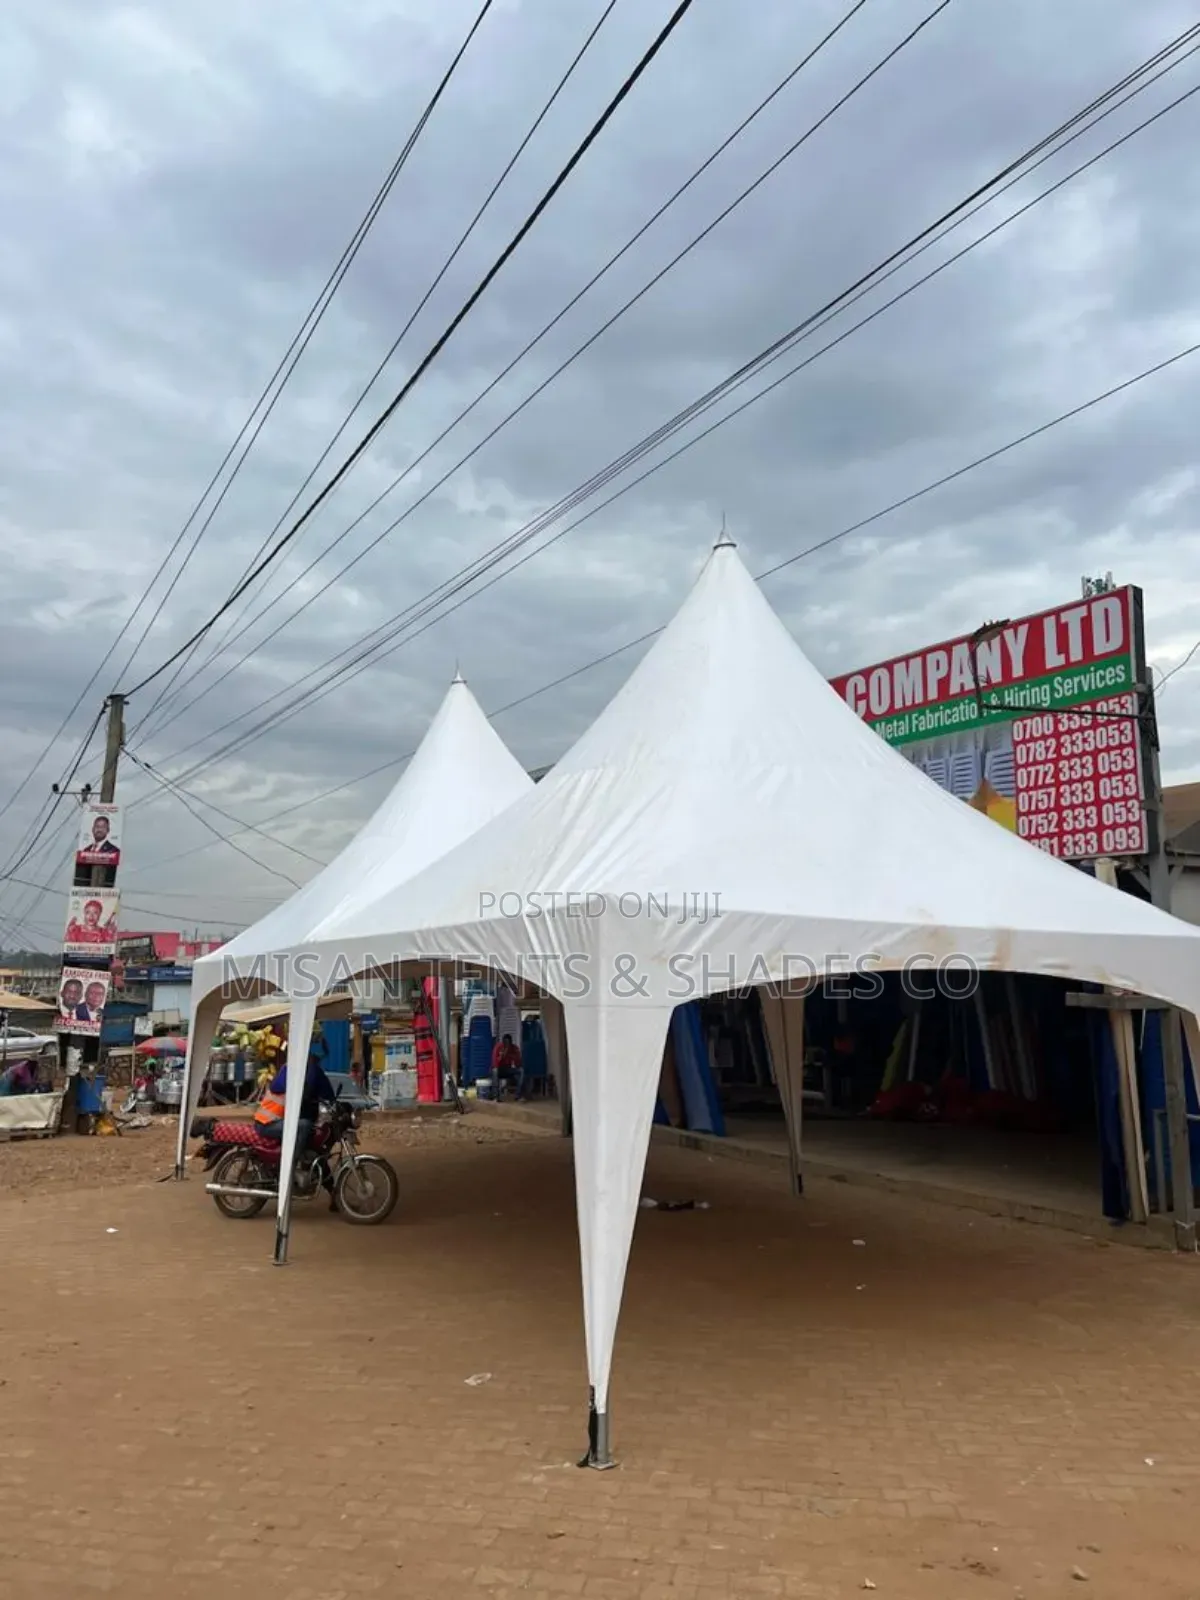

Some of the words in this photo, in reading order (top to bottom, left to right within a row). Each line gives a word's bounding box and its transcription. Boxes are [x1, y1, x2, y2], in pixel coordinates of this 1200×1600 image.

[845, 622, 1029, 719] COMPANY
[1043, 596, 1124, 670] LTD
[875, 713, 909, 741] Metal
[1004, 683, 1051, 708] Hiring
[1053, 663, 1126, 699] Services
[1013, 713, 1054, 742] 0700
[1016, 737, 1057, 765] 0782
[1017, 763, 1055, 789] 0772
[1058, 755, 1094, 782] 333
[1097, 747, 1135, 774] 053
[1018, 787, 1057, 813] 0757
[1059, 780, 1095, 807] 333
[1099, 773, 1137, 801] 053
[1018, 812, 1059, 837] 0752
[1062, 805, 1098, 831] 333
[1102, 799, 1140, 826] 053
[1063, 833, 1099, 856] 333
[1102, 825, 1141, 852] 093
